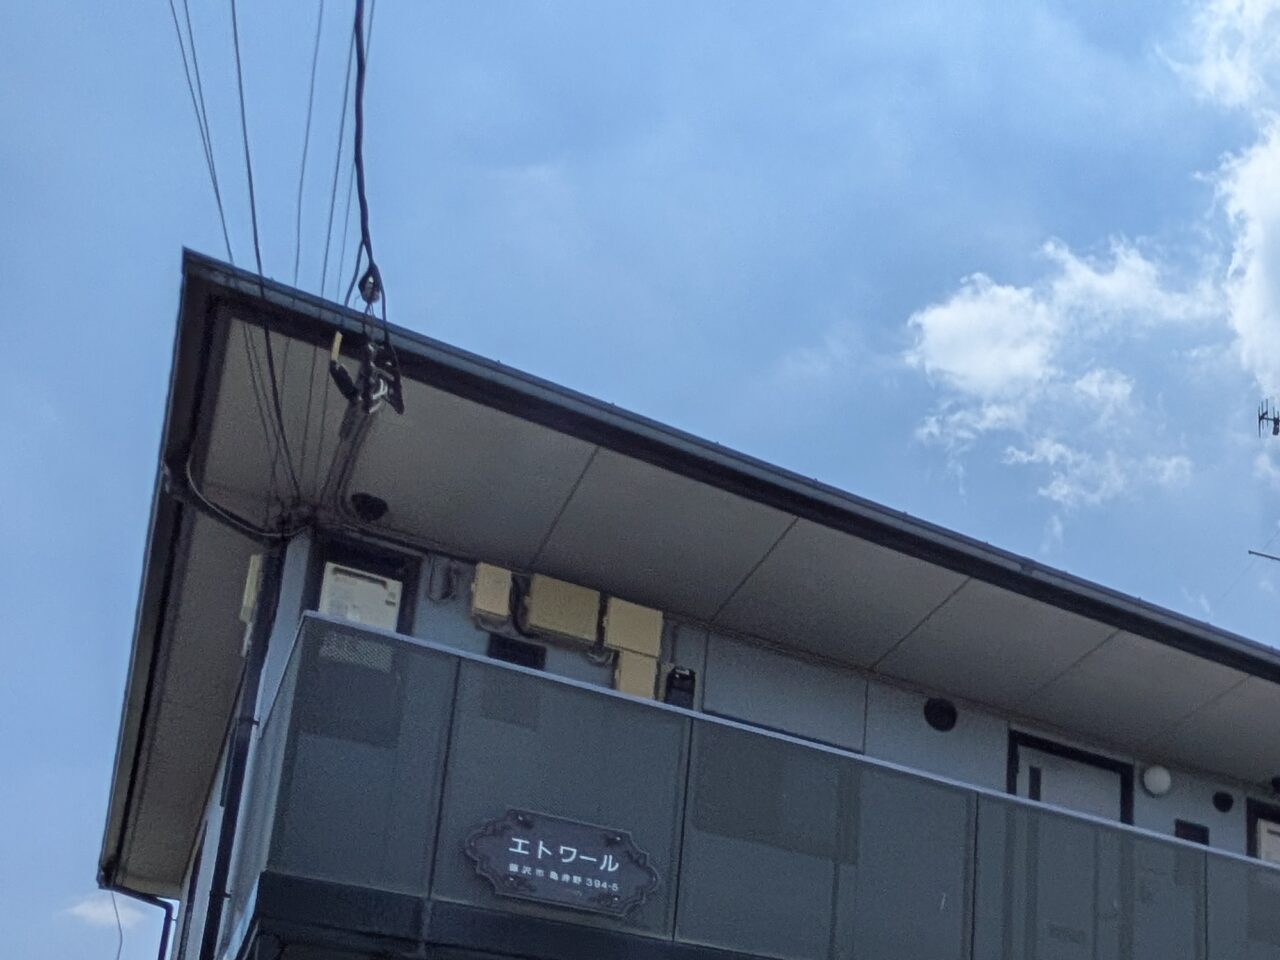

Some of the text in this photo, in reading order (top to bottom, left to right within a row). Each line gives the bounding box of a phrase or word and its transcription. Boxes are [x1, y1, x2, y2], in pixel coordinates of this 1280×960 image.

[508, 837, 619, 872] エトワール
